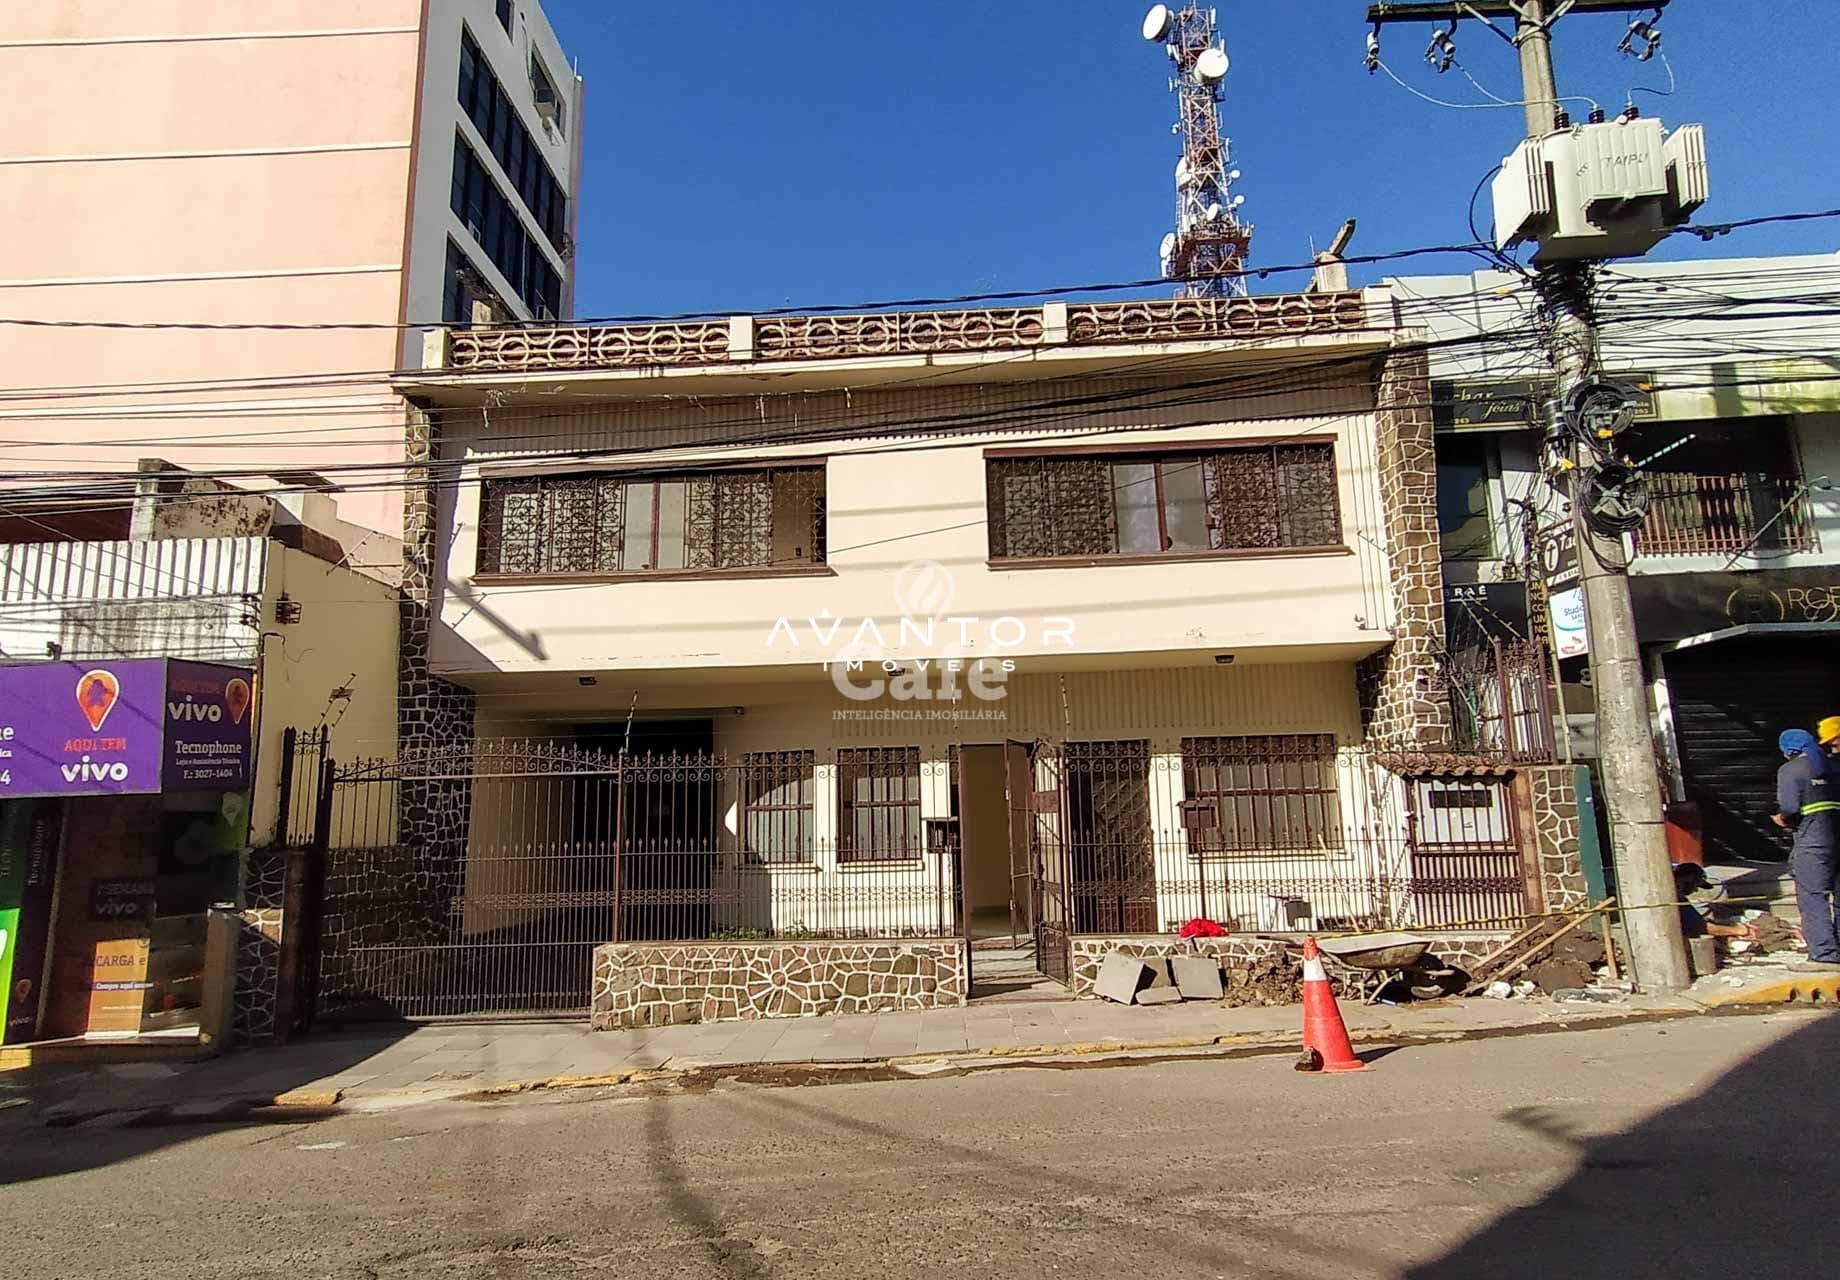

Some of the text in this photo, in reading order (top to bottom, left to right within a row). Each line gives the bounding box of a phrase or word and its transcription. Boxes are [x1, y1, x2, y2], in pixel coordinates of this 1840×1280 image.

[168, 694, 222, 722] vivo
[64, 738, 97, 752] AQUI
[175, 739, 242, 757] Tecnophone
[61, 755, 128, 783] vivo
[96, 955, 134, 967] CARGA
